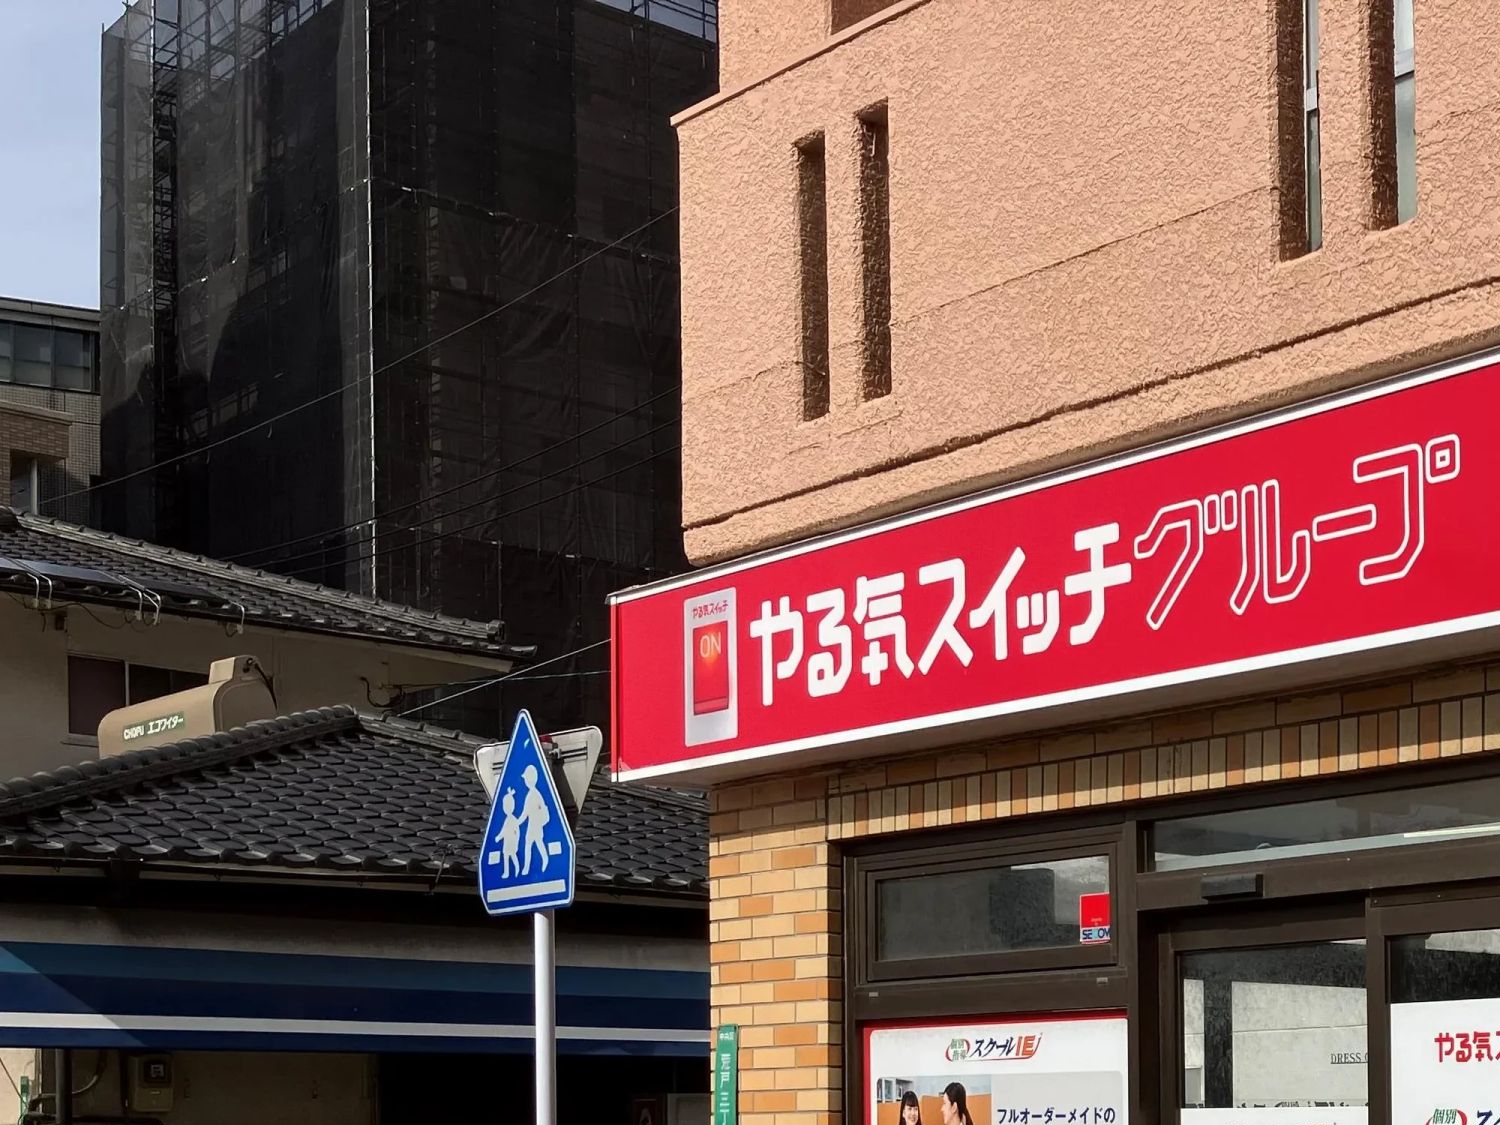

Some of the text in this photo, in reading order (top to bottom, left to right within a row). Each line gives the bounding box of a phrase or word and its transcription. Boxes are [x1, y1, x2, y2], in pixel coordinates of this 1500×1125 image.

[750, 433, 1461, 707] やる気スイッチグループ
[700, 631, 721, 658] ON
[1331, 1052, 1361, 1064] DRESS
[997, 1106, 1116, 1125] フルオーダーメイドの
[1433, 1108, 1458, 1124] 個別
